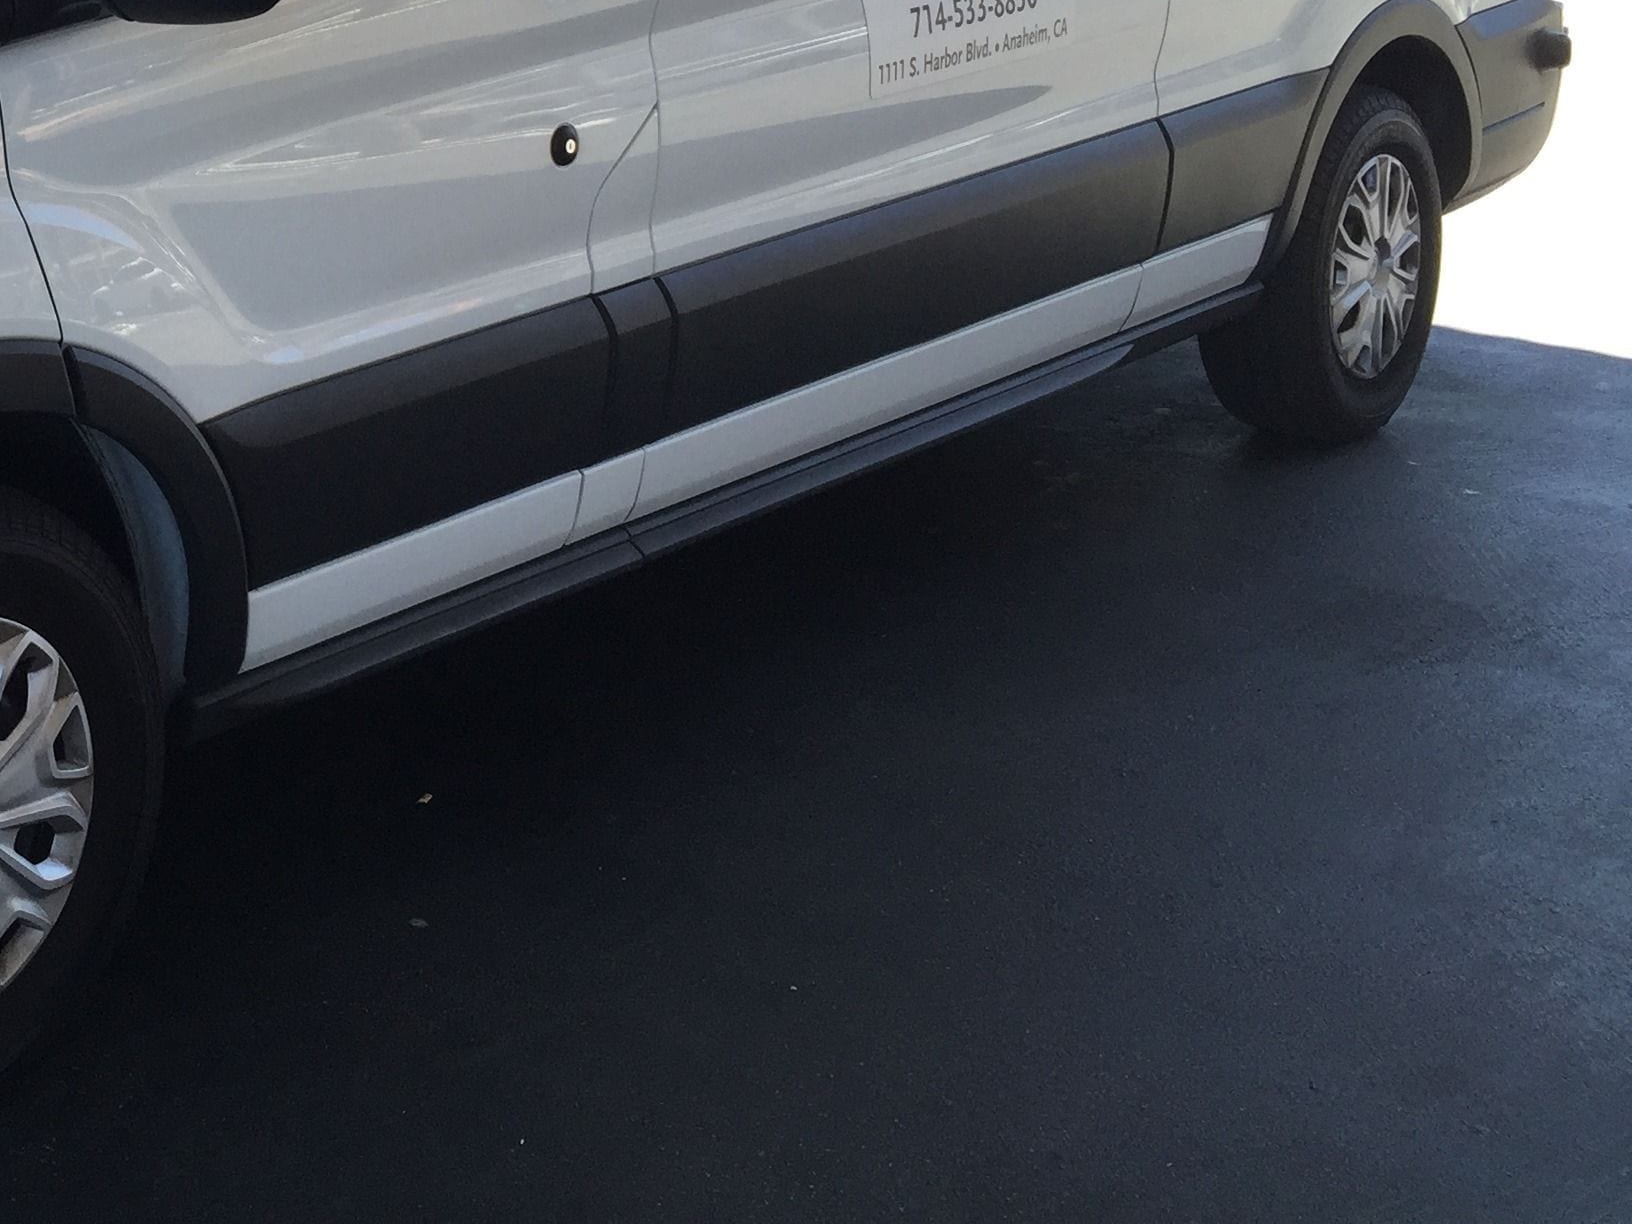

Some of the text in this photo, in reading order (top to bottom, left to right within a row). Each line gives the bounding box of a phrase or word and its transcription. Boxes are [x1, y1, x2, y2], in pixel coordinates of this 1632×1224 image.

[878, 18, 1068, 84] 1111 S. Harbor Blvd. Anaheim, CA
